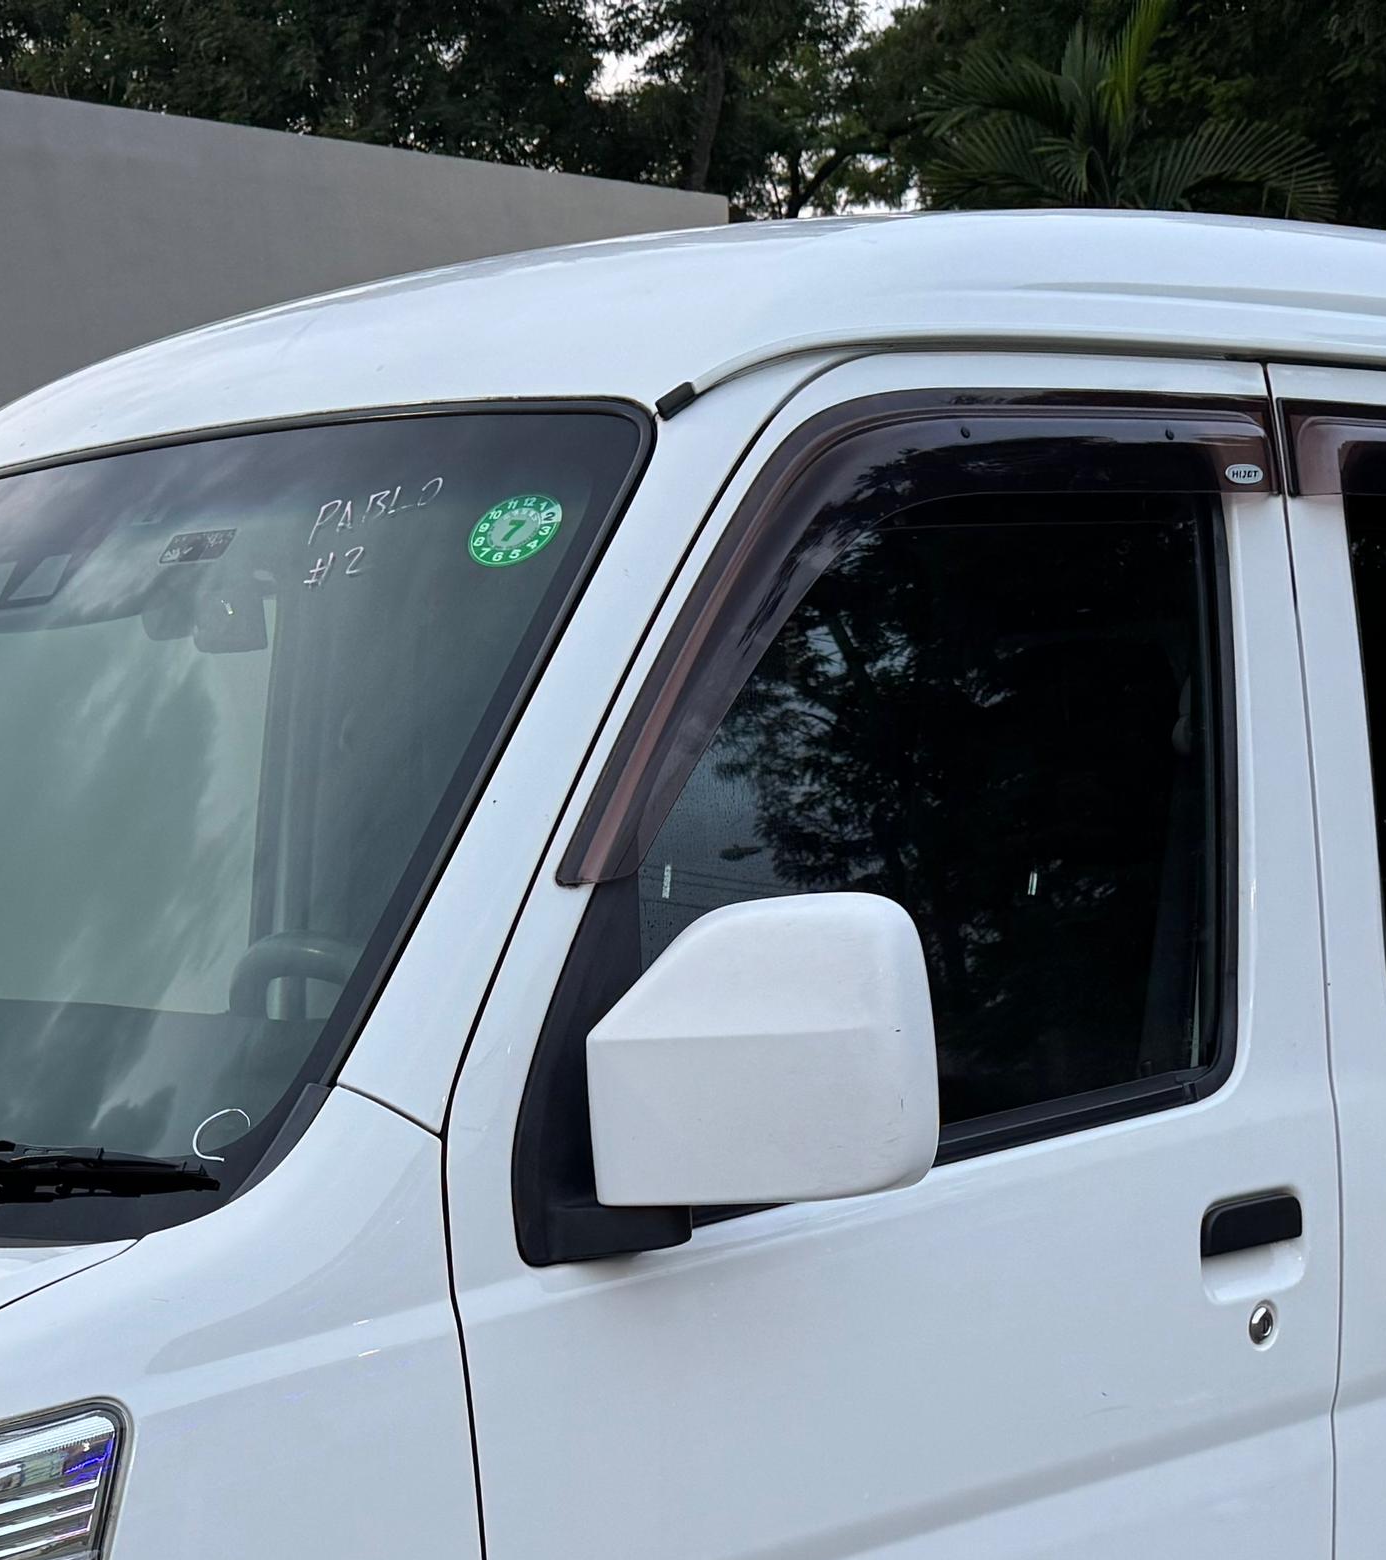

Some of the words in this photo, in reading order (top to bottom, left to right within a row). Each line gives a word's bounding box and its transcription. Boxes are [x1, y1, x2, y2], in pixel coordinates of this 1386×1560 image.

[1231, 469, 1259, 479] HIJET
[507, 499, 519, 509] 11
[523, 496, 537, 507] 12
[308, 476, 444, 545] PABLO
[489, 509, 502, 519] 10
[543, 511, 556, 522] 2
[478, 523, 490, 532] 9
[500, 519, 527, 542] 7
[538, 526, 551, 535] 3
[473, 536, 485, 546] 8
[526, 539, 539, 549] 4
[479, 548, 491, 557] 7
[492, 552, 504, 561] 6
[509, 549, 521, 558] 5
